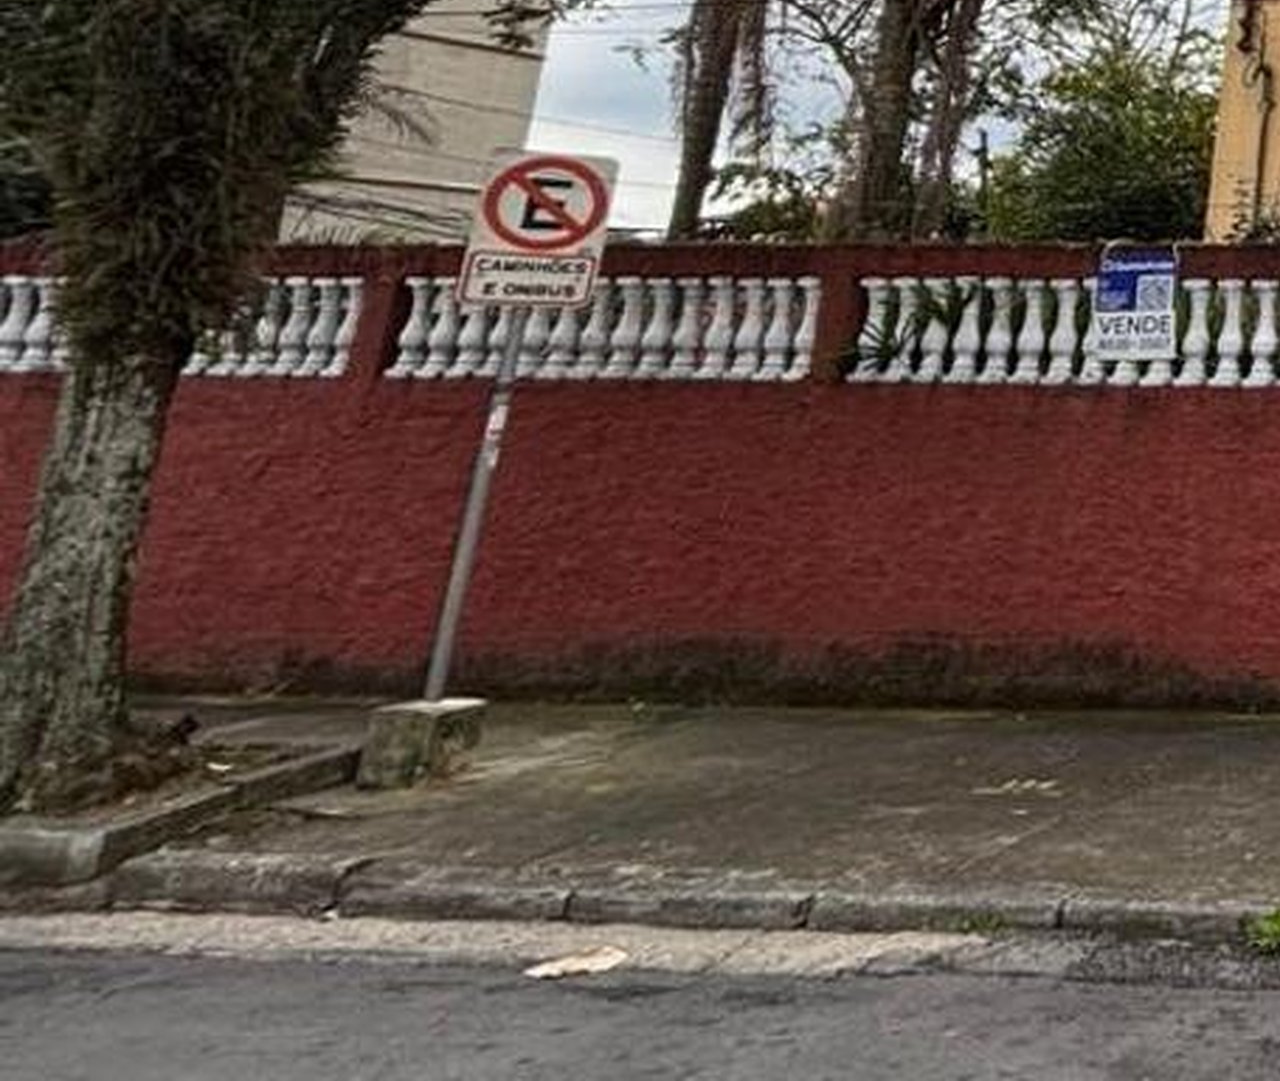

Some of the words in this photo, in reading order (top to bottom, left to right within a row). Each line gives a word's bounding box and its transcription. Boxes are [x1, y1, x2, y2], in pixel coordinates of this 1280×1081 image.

[520, 177, 573, 229] E
[483, 282, 498, 295] E
[1098, 314, 1171, 335] VENDE
